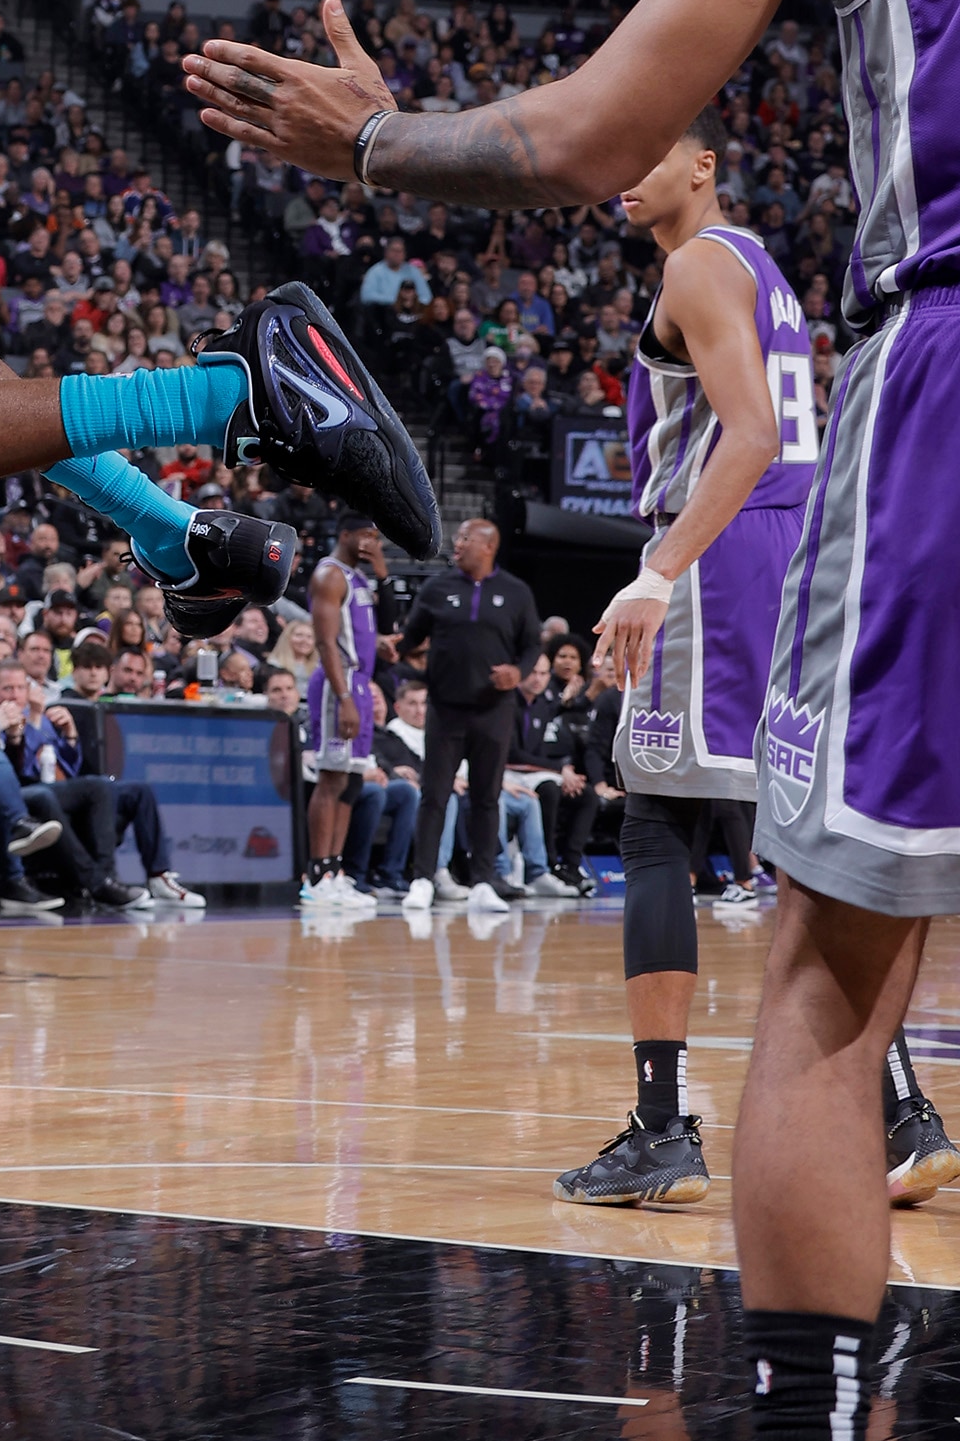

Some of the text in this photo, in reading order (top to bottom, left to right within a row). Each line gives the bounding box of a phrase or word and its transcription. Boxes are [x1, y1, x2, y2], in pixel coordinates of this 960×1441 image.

[573, 439, 632, 480] AE
[191, 522, 212, 536] EASY
[631, 731, 680, 750] SAC
[768, 736, 815, 785] SAC
